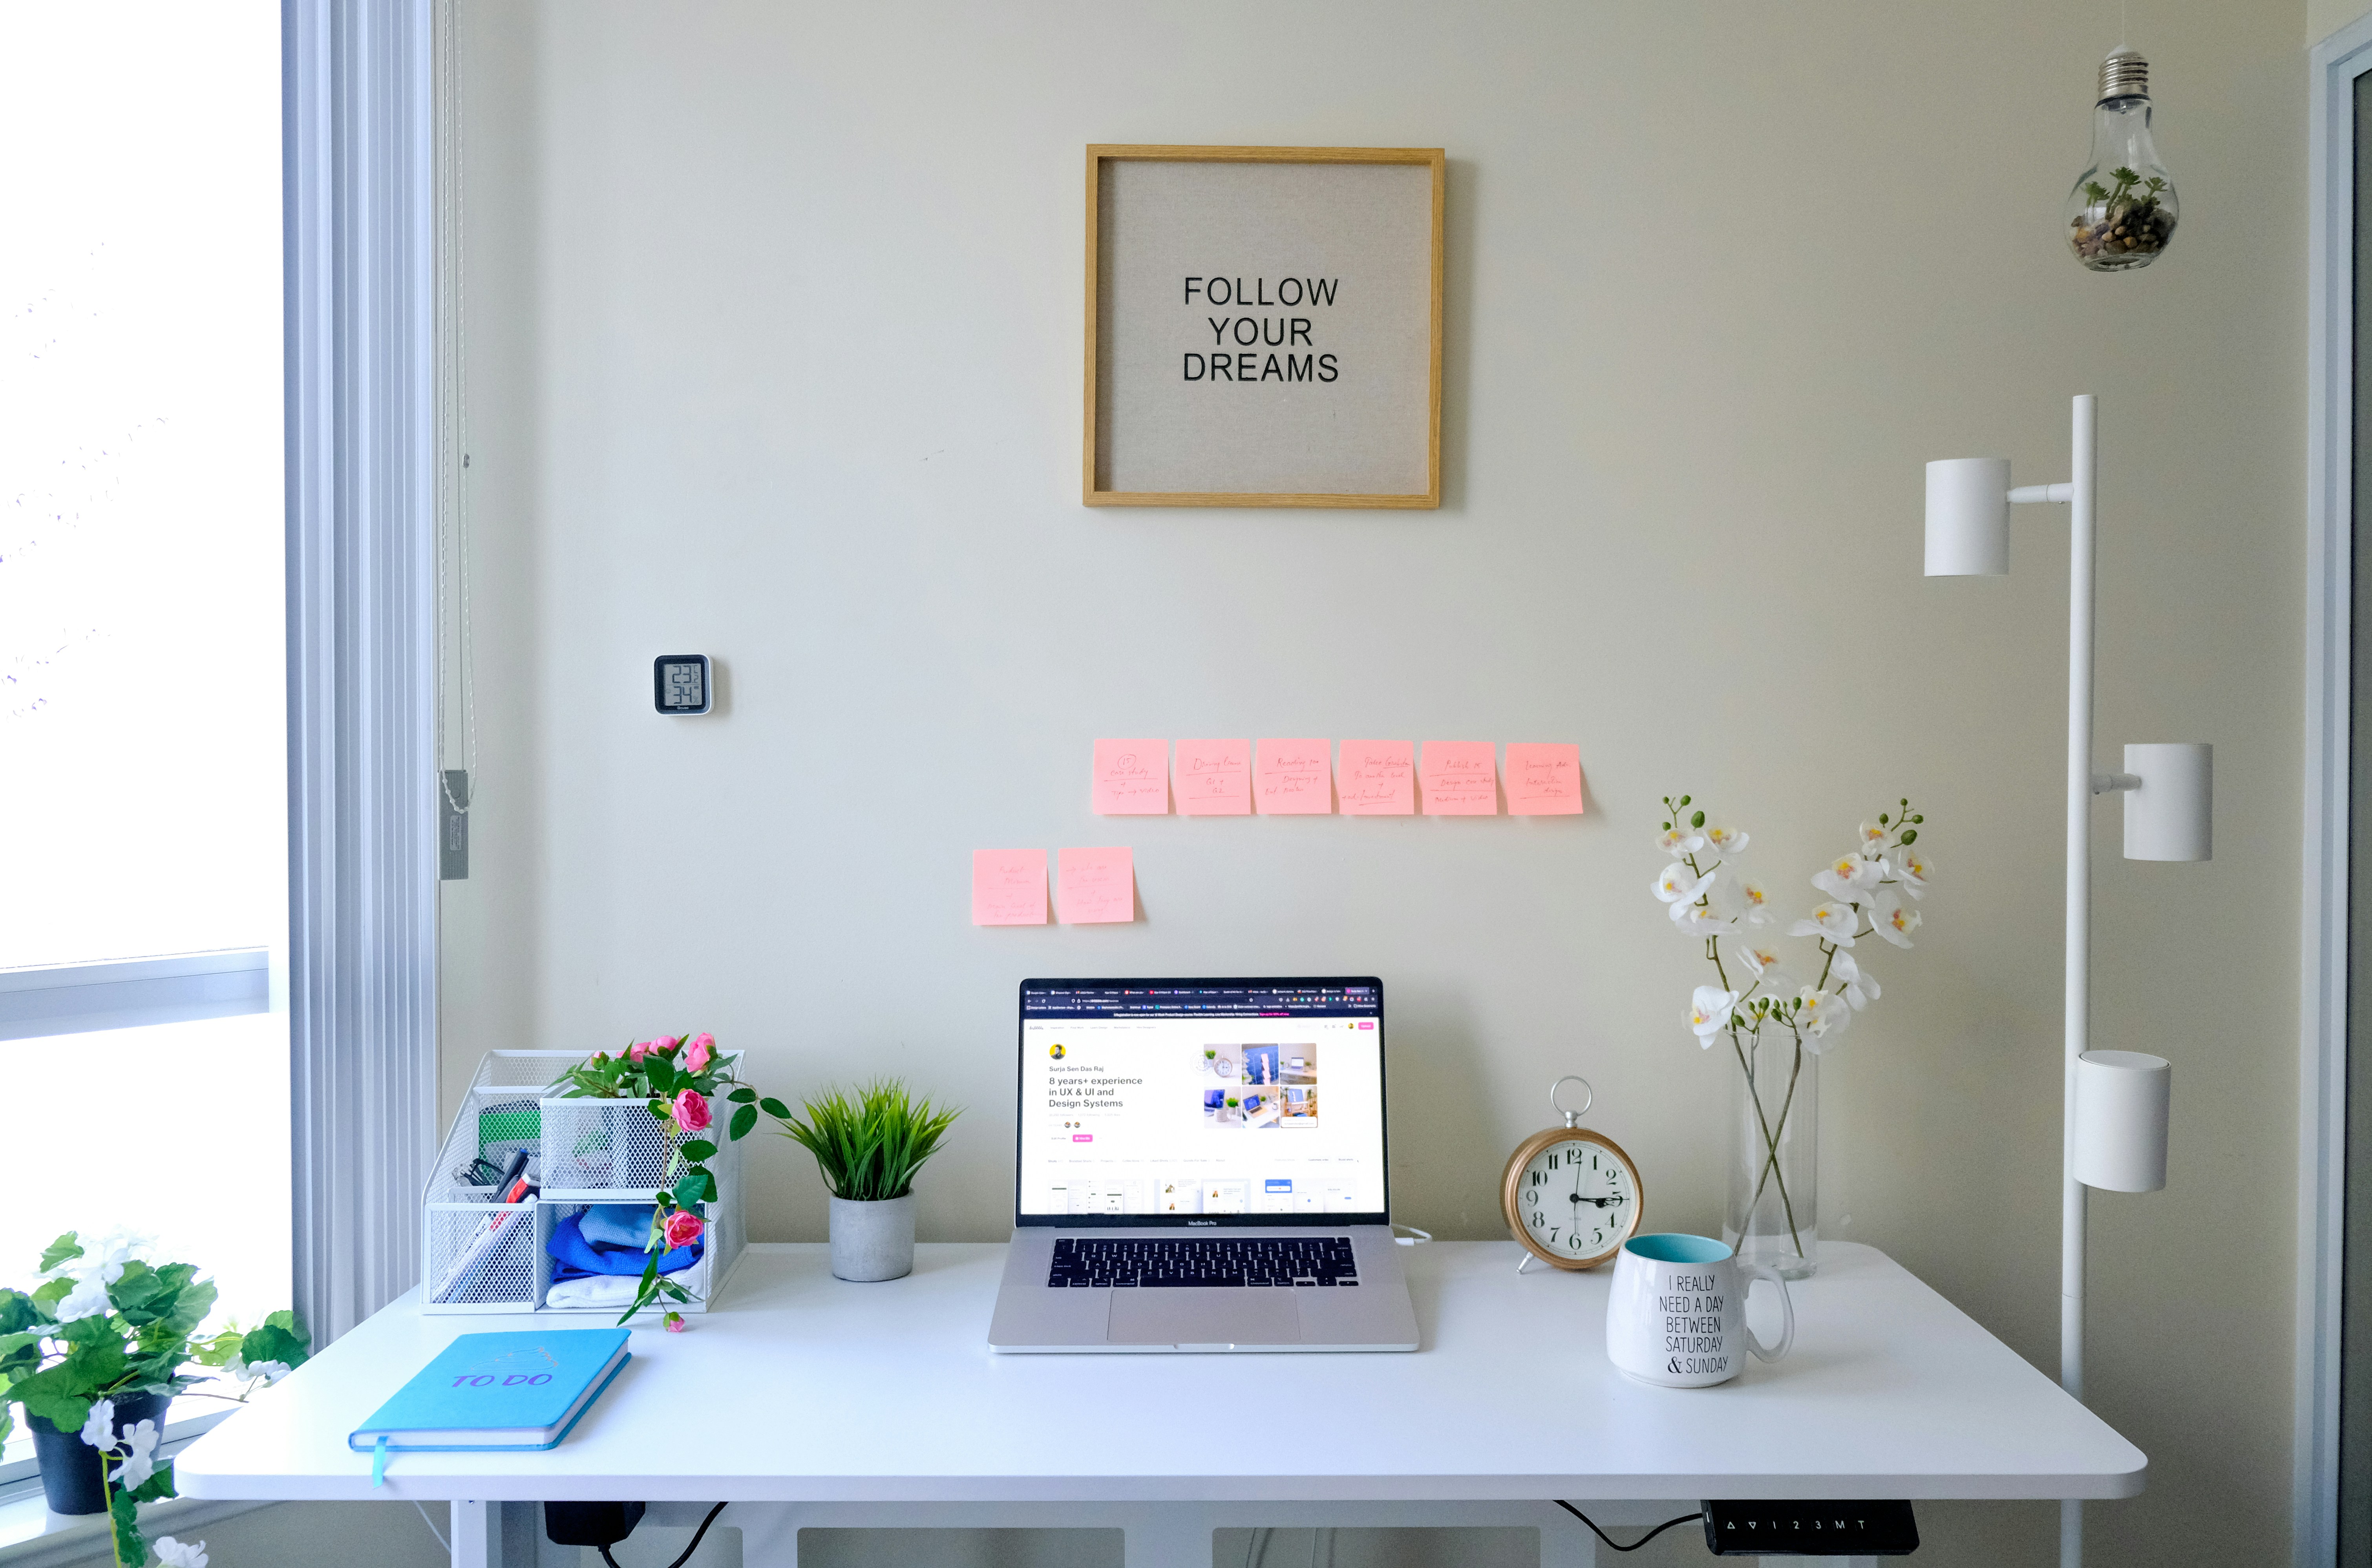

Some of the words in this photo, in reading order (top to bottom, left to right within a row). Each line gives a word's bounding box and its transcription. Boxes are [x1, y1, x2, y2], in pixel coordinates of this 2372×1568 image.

[1184, 277, 1339, 307] FOLLOW
[1208, 317, 1313, 347] YOUR
[1184, 353, 1339, 383] DREAMS
[1277, 757, 1305, 772] Reading
[1129, 767, 1148, 779] study
[1091, 1077, 1142, 1086] experience
[1049, 1100, 1080, 1108] Design
[1084, 1099, 1123, 1108] Systems
[1548, 1154, 1558, 1170] 11
[1567, 1148, 1582, 1165] 12
[1593, 1154, 1597, 1170] 1
[1533, 1170, 1548, 1186] 10
[1606, 1169, 1617, 1185] 2
[1526, 1190, 1539, 1207] 9
[1533, 1212, 1545, 1228] 8
[1605, 1212, 1617, 1228] 4
[1550, 1227, 1561, 1243] 7
[1569, 1233, 1582, 1250] 6
[1591, 1228, 1602, 1245] 5
[1669, 1275, 1672, 1291] I
[1677, 1274, 1715, 1292] REALLY
[1659, 1296, 1690, 1313] NEED
[1694, 1297, 1702, 1313] A
[1706, 1296, 1723, 1313] DAY
[1667, 1316, 1721, 1334] BETWEEN
[1665, 1336, 1723, 1353] SATURDAY
[1667, 1356, 1682, 1374] &
[1686, 1356, 1728, 1374] SUNDAY
[452, 1375, 495, 1387] TO
[502, 1374, 553, 1386] DO
[1793, 1521, 1800, 1529] 2
[1815, 1521, 1822, 1529] 3
[1835, 1521, 1845, 1529] M
[1858, 1520, 1864, 1529] T
